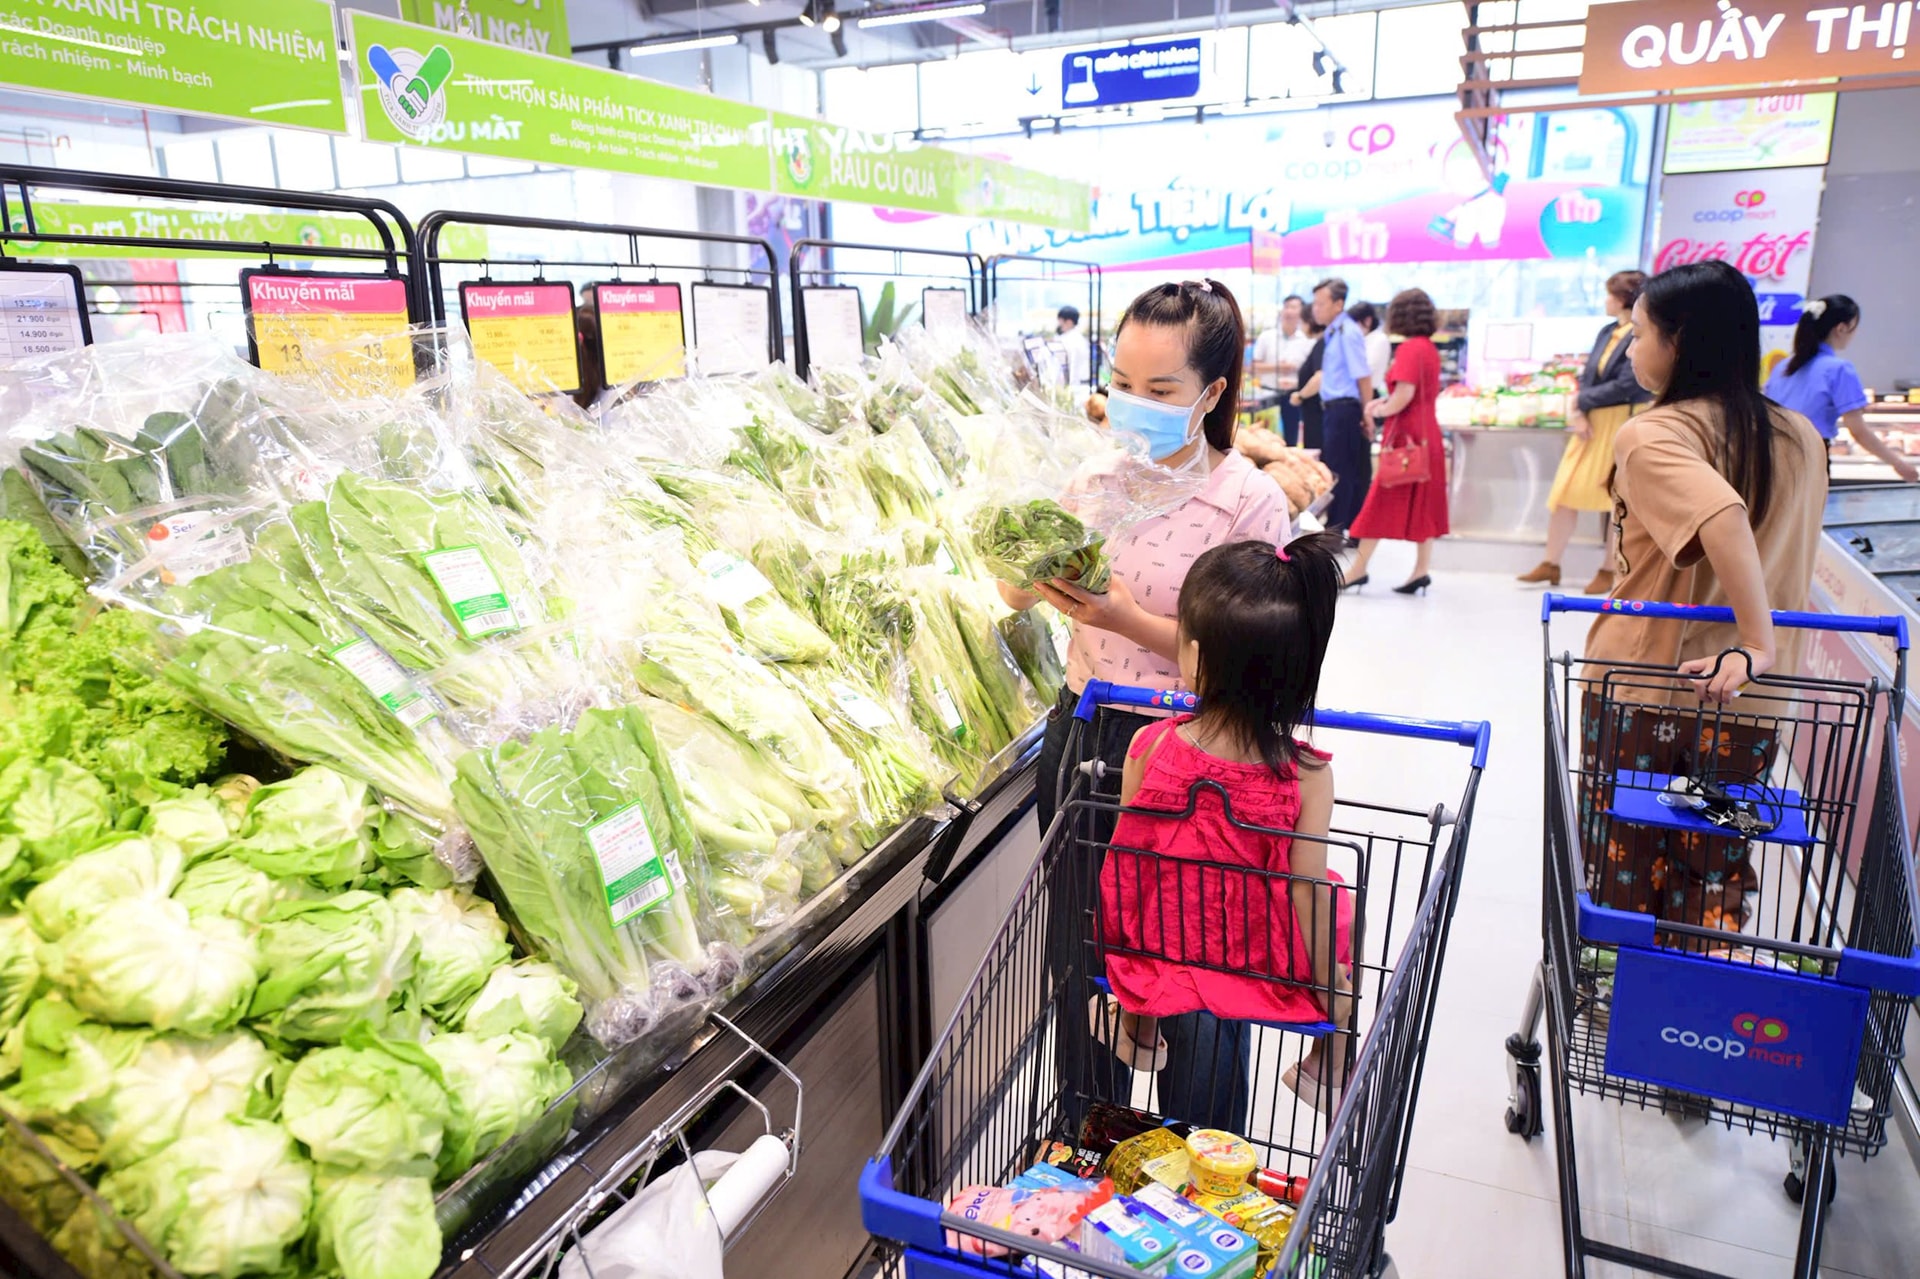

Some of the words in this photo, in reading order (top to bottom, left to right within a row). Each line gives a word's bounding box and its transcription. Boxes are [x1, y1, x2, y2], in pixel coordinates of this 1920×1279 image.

[38, 16, 100, 43] Doanh
[105, 31, 166, 59] nghiệp
[146, 3, 243, 46] TRÁCH
[246, 27, 327, 63] NHIỆM
[1621, 0, 1786, 69] QUẦY
[1806, 1, 1920, 59] THỊ
[52, 47, 111, 71] nhiệm
[127, 59, 169, 80] Minh
[173, 66, 214, 88] bạch
[498, 82, 546, 108] CHỌN
[626, 106, 656, 126] TICK
[658, 112, 692, 134] XANH
[1734, 230, 1811, 277] tốt
[252, 282, 321, 305] Khuyến
[325, 284, 355, 301] mãi
[466, 290, 512, 310] Khuyến
